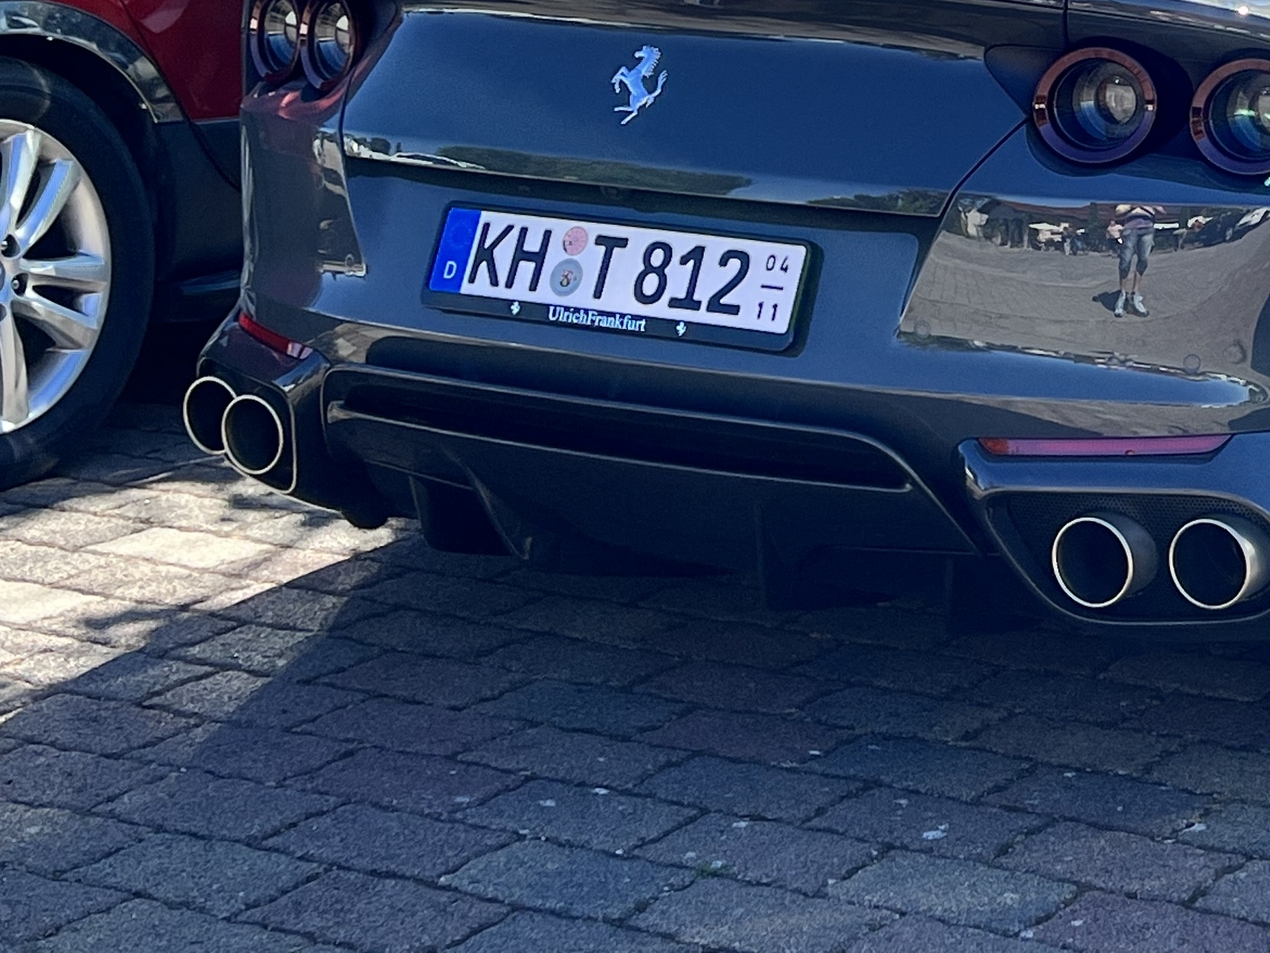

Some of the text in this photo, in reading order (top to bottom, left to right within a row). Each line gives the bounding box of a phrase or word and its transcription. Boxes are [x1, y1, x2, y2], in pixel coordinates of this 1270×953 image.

[443, 260, 457, 280] D
[468, 222, 752, 316] KH T 812
[765, 254, 790, 274] 04
[548, 306, 647, 332] UlrichFrankfurt
[756, 301, 780, 322] 11
